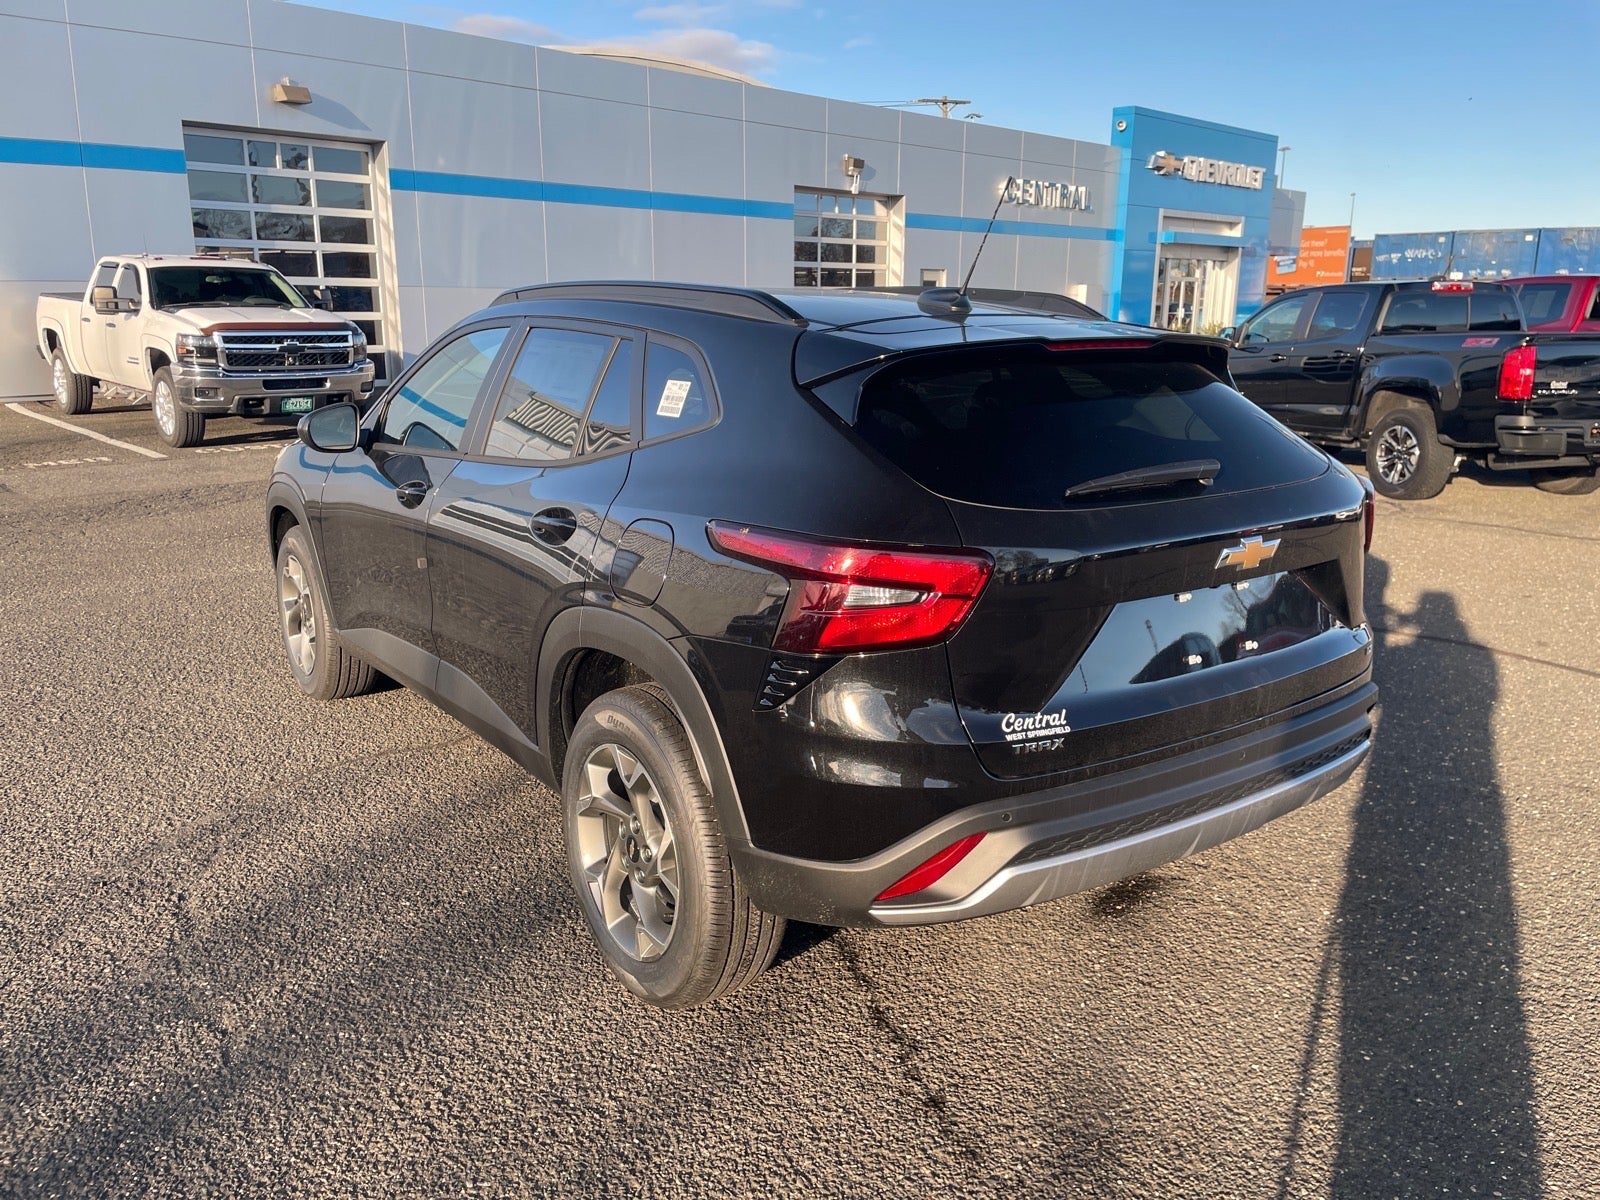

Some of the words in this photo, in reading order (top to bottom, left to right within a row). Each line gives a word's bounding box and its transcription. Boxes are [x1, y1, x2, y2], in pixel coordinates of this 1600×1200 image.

[1181, 156, 1266, 190] CHEVROLET
[1000, 177, 1093, 213] CENTRAL
[1001, 708, 1067, 733] Central
[1005, 731, 1026, 742] WEST
[1027, 725, 1071, 739] SPRINGFIELD
[1011, 737, 1065, 755] TRAX
